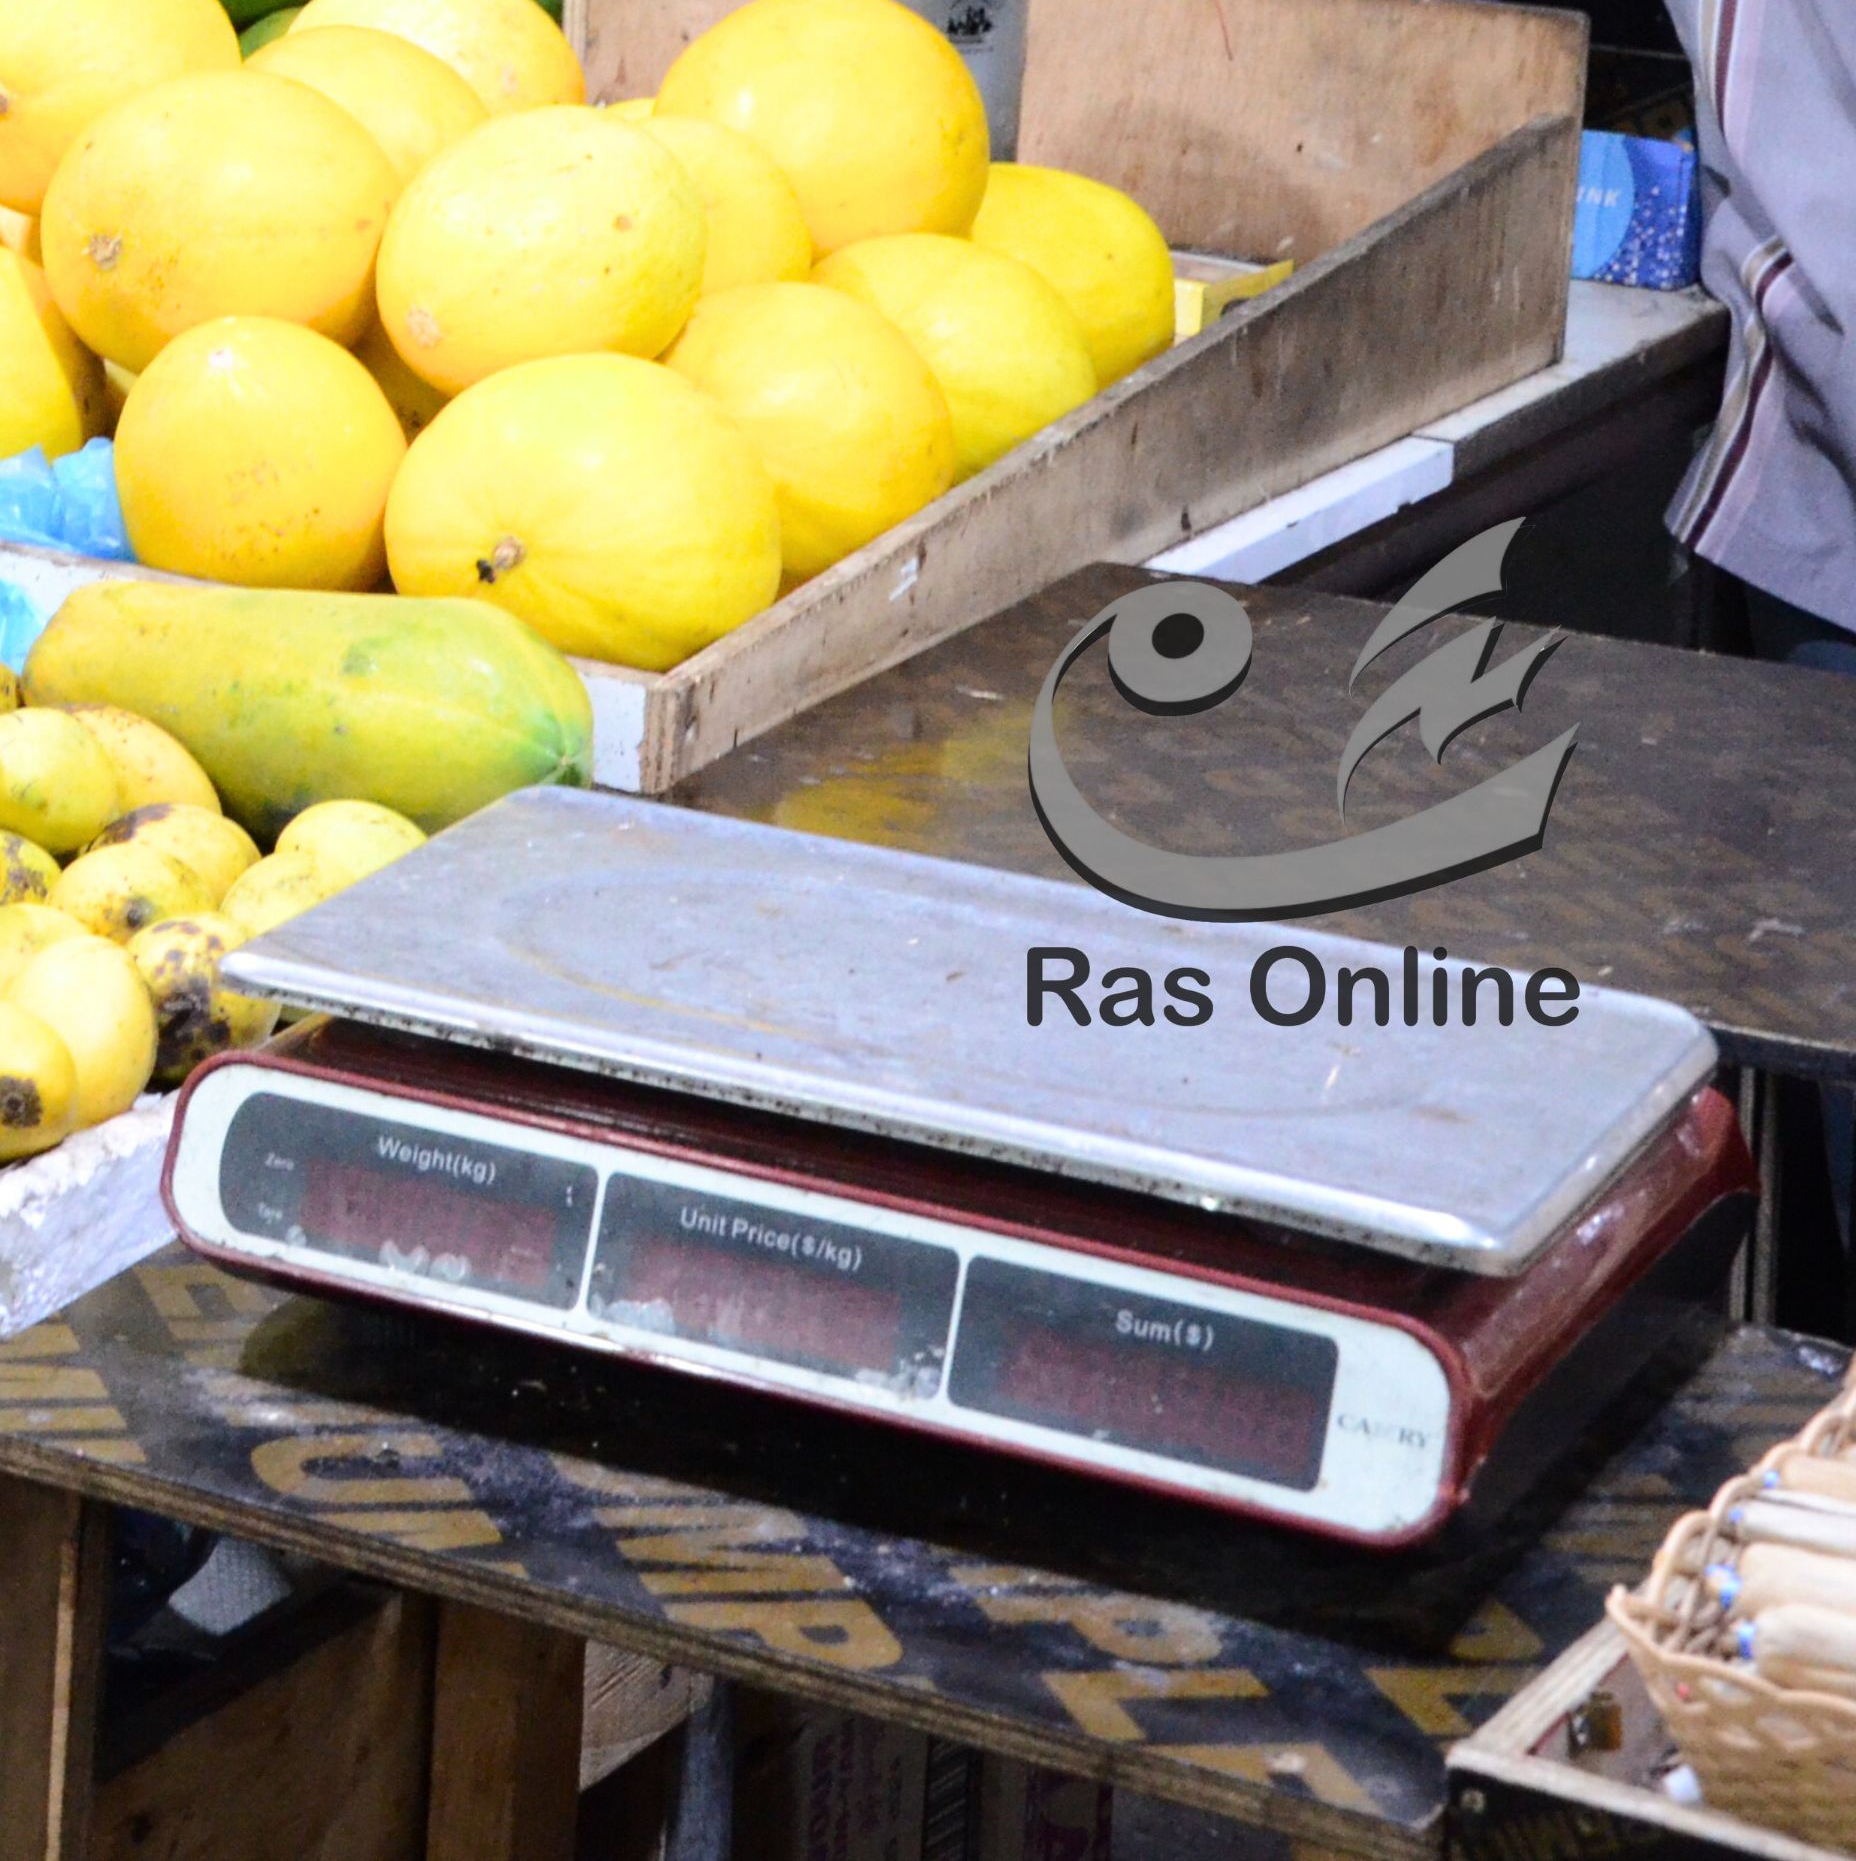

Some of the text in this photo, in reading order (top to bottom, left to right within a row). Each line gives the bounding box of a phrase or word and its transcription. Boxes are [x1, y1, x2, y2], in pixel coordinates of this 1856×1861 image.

[377, 1136, 496, 1185] Weight(kg)
[680, 1206, 863, 1272] Unit Price($/kg)
[1114, 1308, 1216, 1352] Sum($)
[1336, 1413, 1431, 1451] CARY
